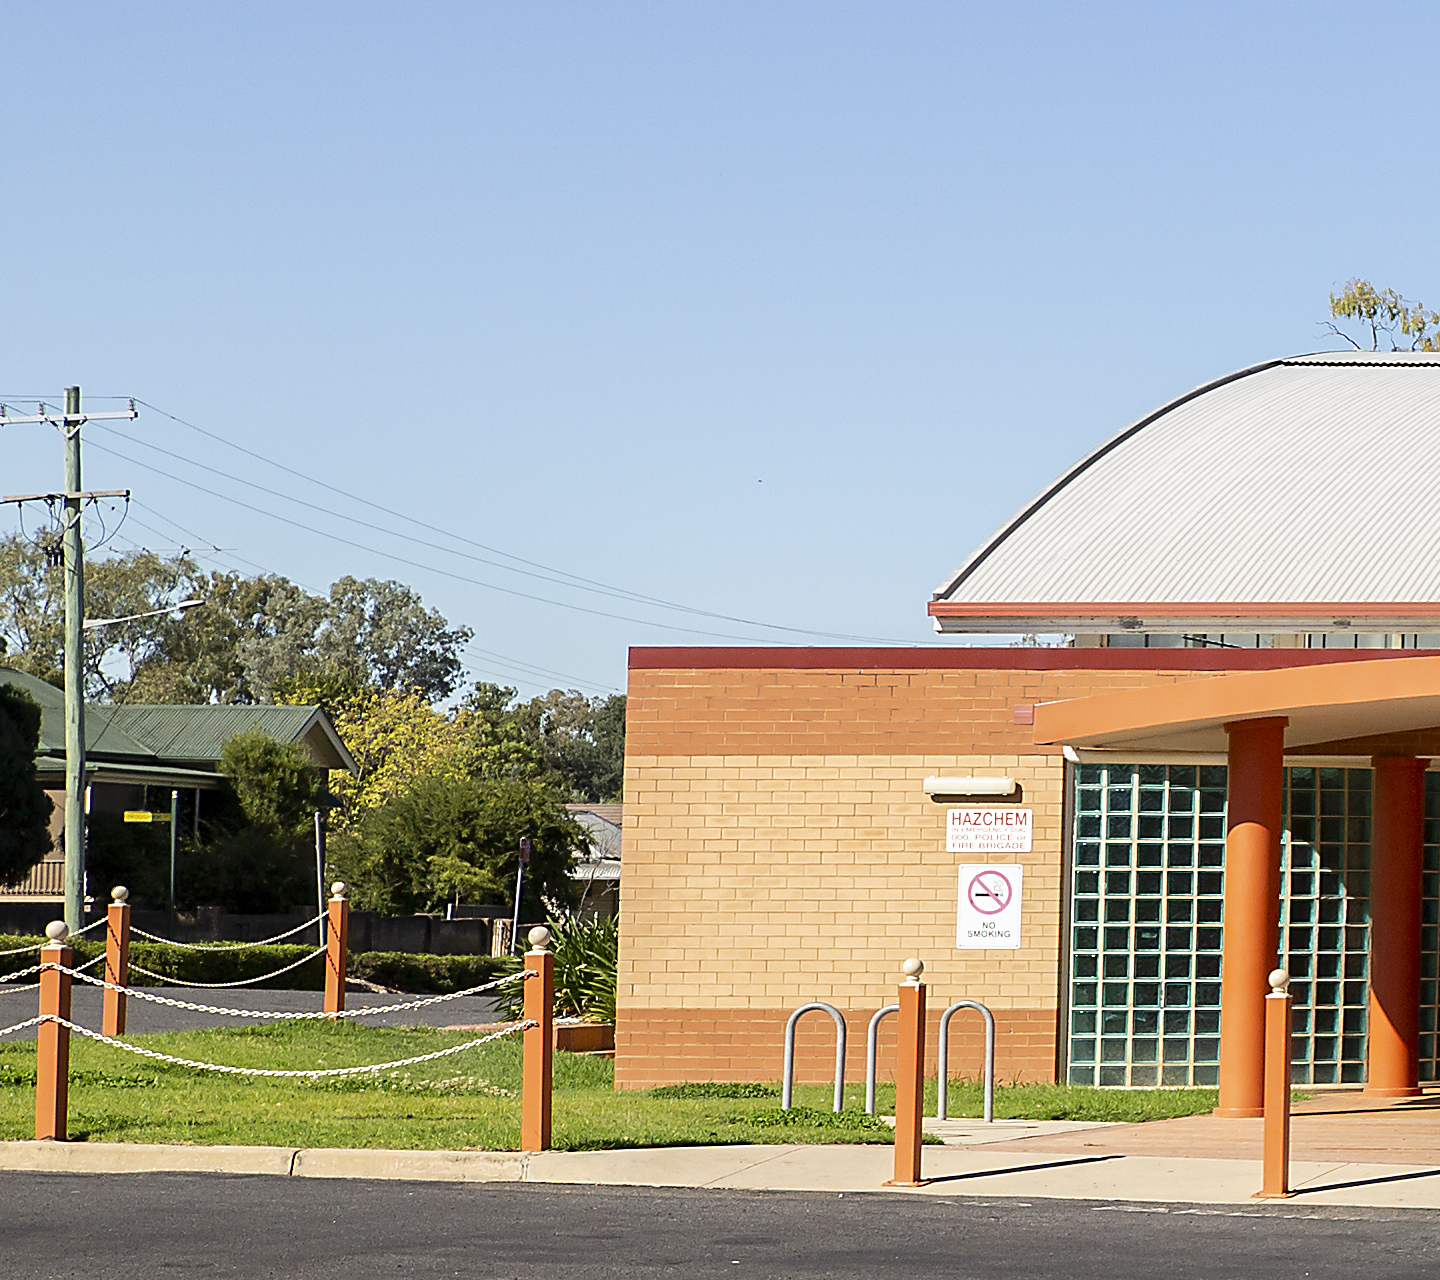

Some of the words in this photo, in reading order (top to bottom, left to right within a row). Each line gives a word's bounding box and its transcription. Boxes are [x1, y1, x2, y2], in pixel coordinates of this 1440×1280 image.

[951, 812, 1027, 826] HAZCHEM
[982, 921, 996, 930] NO
[967, 930, 1011, 938] SMOKING
